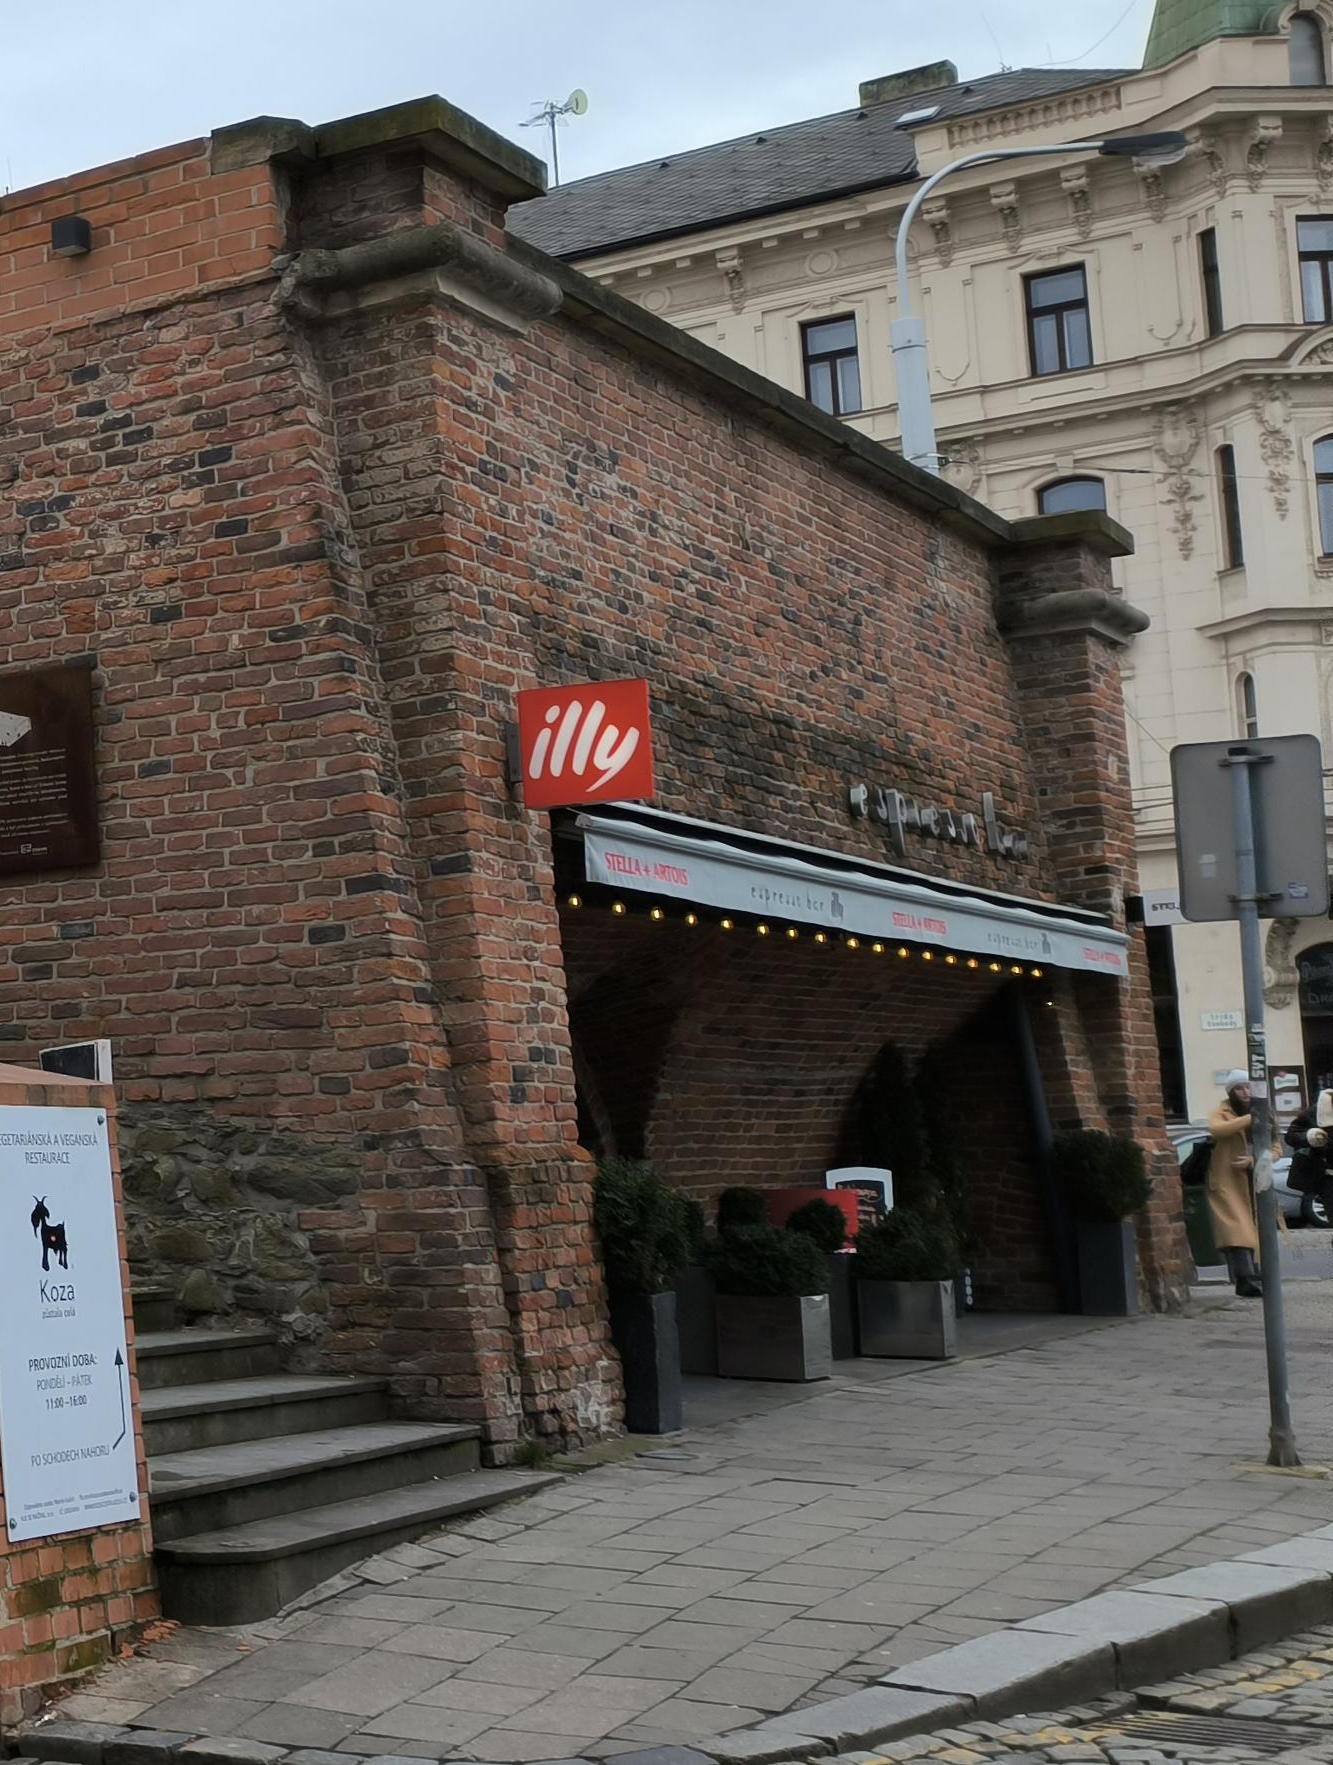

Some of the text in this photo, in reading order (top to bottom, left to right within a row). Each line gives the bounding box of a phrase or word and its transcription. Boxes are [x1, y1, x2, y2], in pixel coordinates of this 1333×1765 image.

[529, 700, 640, 793] illy
[850, 783, 980, 857] espresso
[604, 852, 690, 887] STELLA ARTOIS
[53, 1133, 60, 1146] A
[59, 1131, 99, 1146] VEGANSKÁ
[25, 1151, 71, 1165] RESTAURACE
[39, 1279, 75, 1303] Koza
[28, 1352, 99, 1372] PROVOZNÍ DOBA:
[36, 1374, 65, 1391] PONDĚLÍ
[71, 1372, 93, 1388] PÁTEK
[31, 1444, 110, 1467] PO SCHODECH NAHORU
